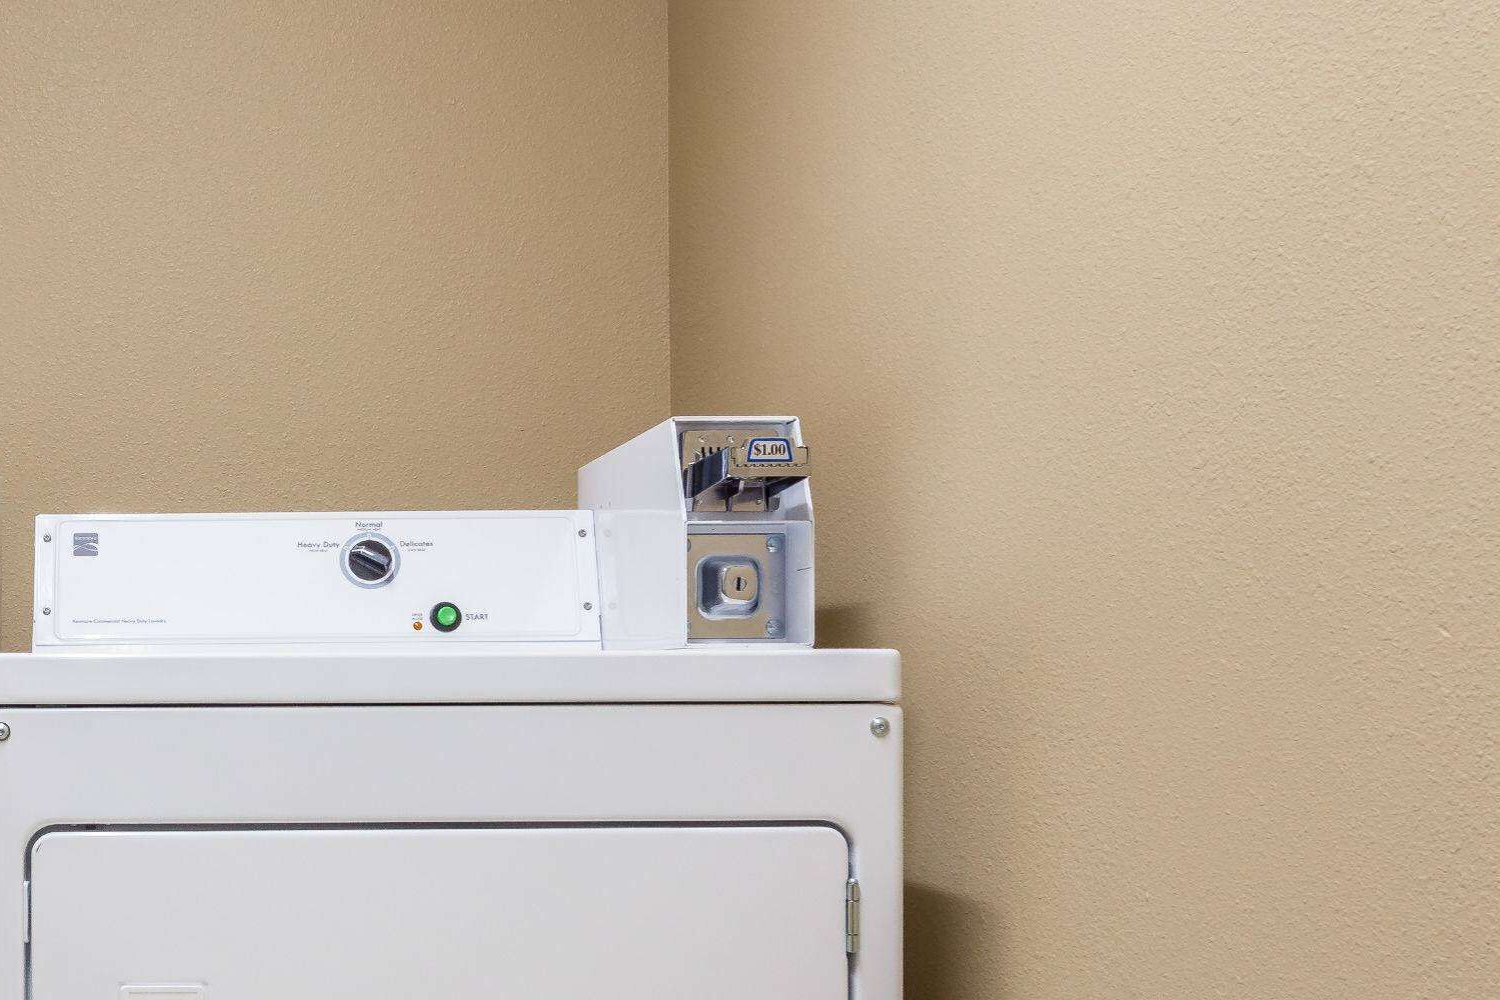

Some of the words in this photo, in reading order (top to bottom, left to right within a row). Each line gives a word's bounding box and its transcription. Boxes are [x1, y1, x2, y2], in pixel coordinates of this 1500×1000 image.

[753, 443, 786, 456] $1.00
[297, 541, 321, 549] Heavy
[323, 541, 340, 549] Duty
[465, 613, 489, 621] START
